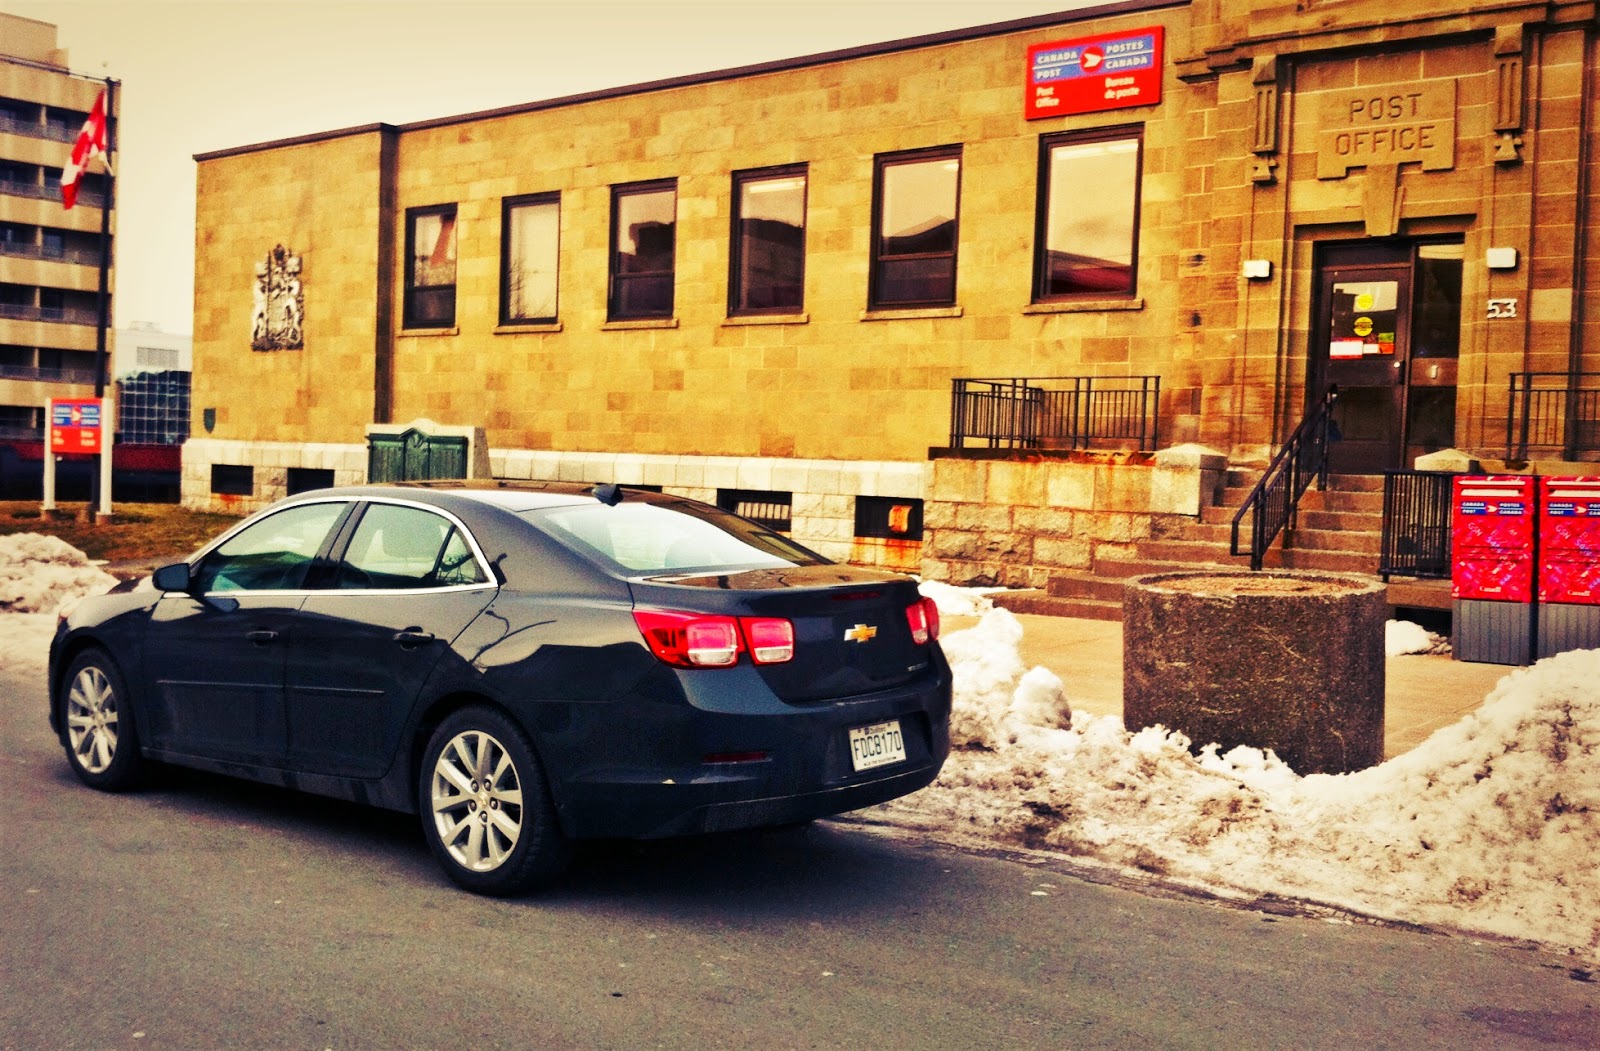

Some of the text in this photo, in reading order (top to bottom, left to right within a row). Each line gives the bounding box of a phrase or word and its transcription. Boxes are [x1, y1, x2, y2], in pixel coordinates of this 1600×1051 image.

[1105, 40, 1145, 54] POSTES
[1037, 50, 1078, 64] CANADA
[1105, 56, 1148, 70] CANADA
[1036, 68, 1062, 79] POST
[1036, 86, 1054, 97] Post
[1104, 87, 1140, 100] de poste
[1348, 92, 1423, 123] POST
[1334, 125, 1436, 156] OFFICE
[1486, 298, 1518, 319] 53
[853, 730, 902, 761] FDC8170
